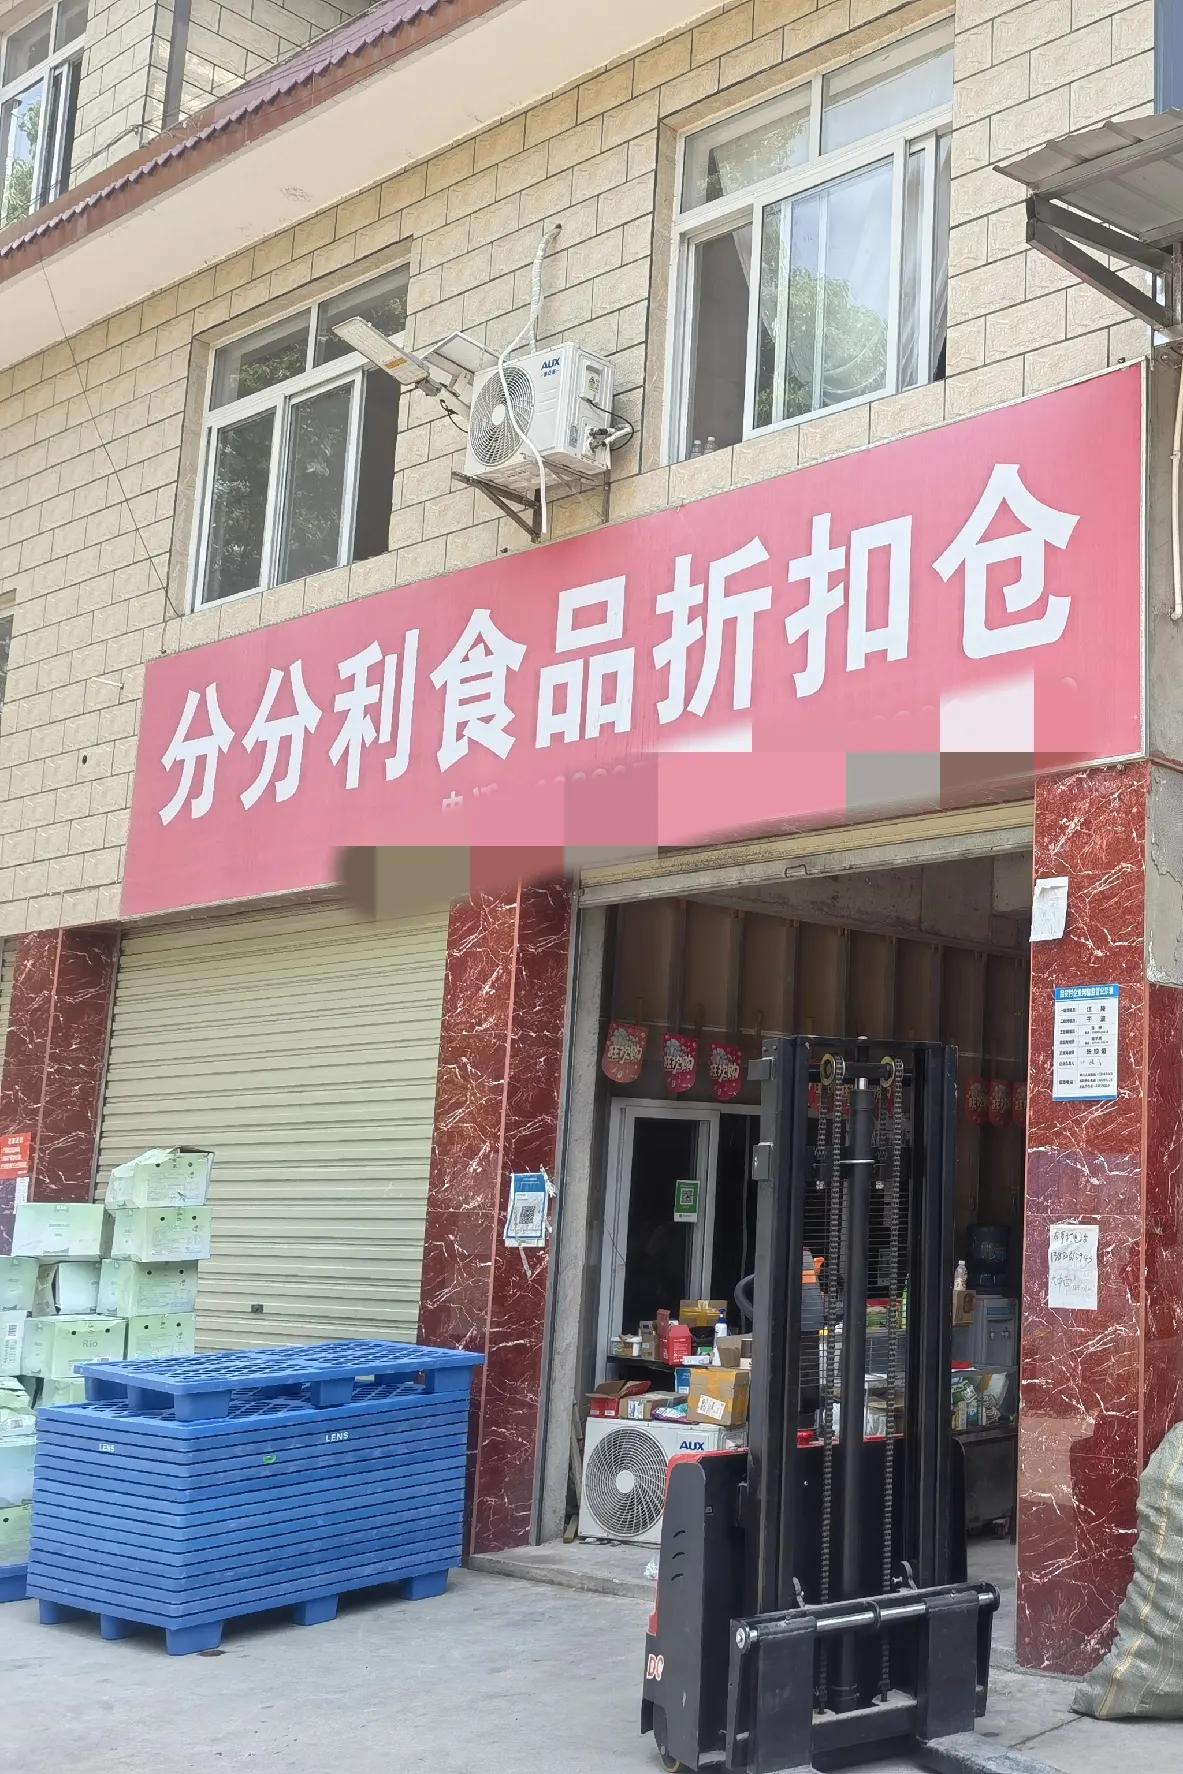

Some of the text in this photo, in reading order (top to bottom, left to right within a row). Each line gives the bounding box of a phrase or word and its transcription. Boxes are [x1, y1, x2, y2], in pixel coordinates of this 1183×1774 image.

[541, 357, 560, 370] AUX
[159, 463, 1081, 827] 分分利食品折扣仓
[325, 1431, 349, 1442] LENS
[98, 1443, 115, 1452] LENS
[680, 1440, 704, 1451] AUX
